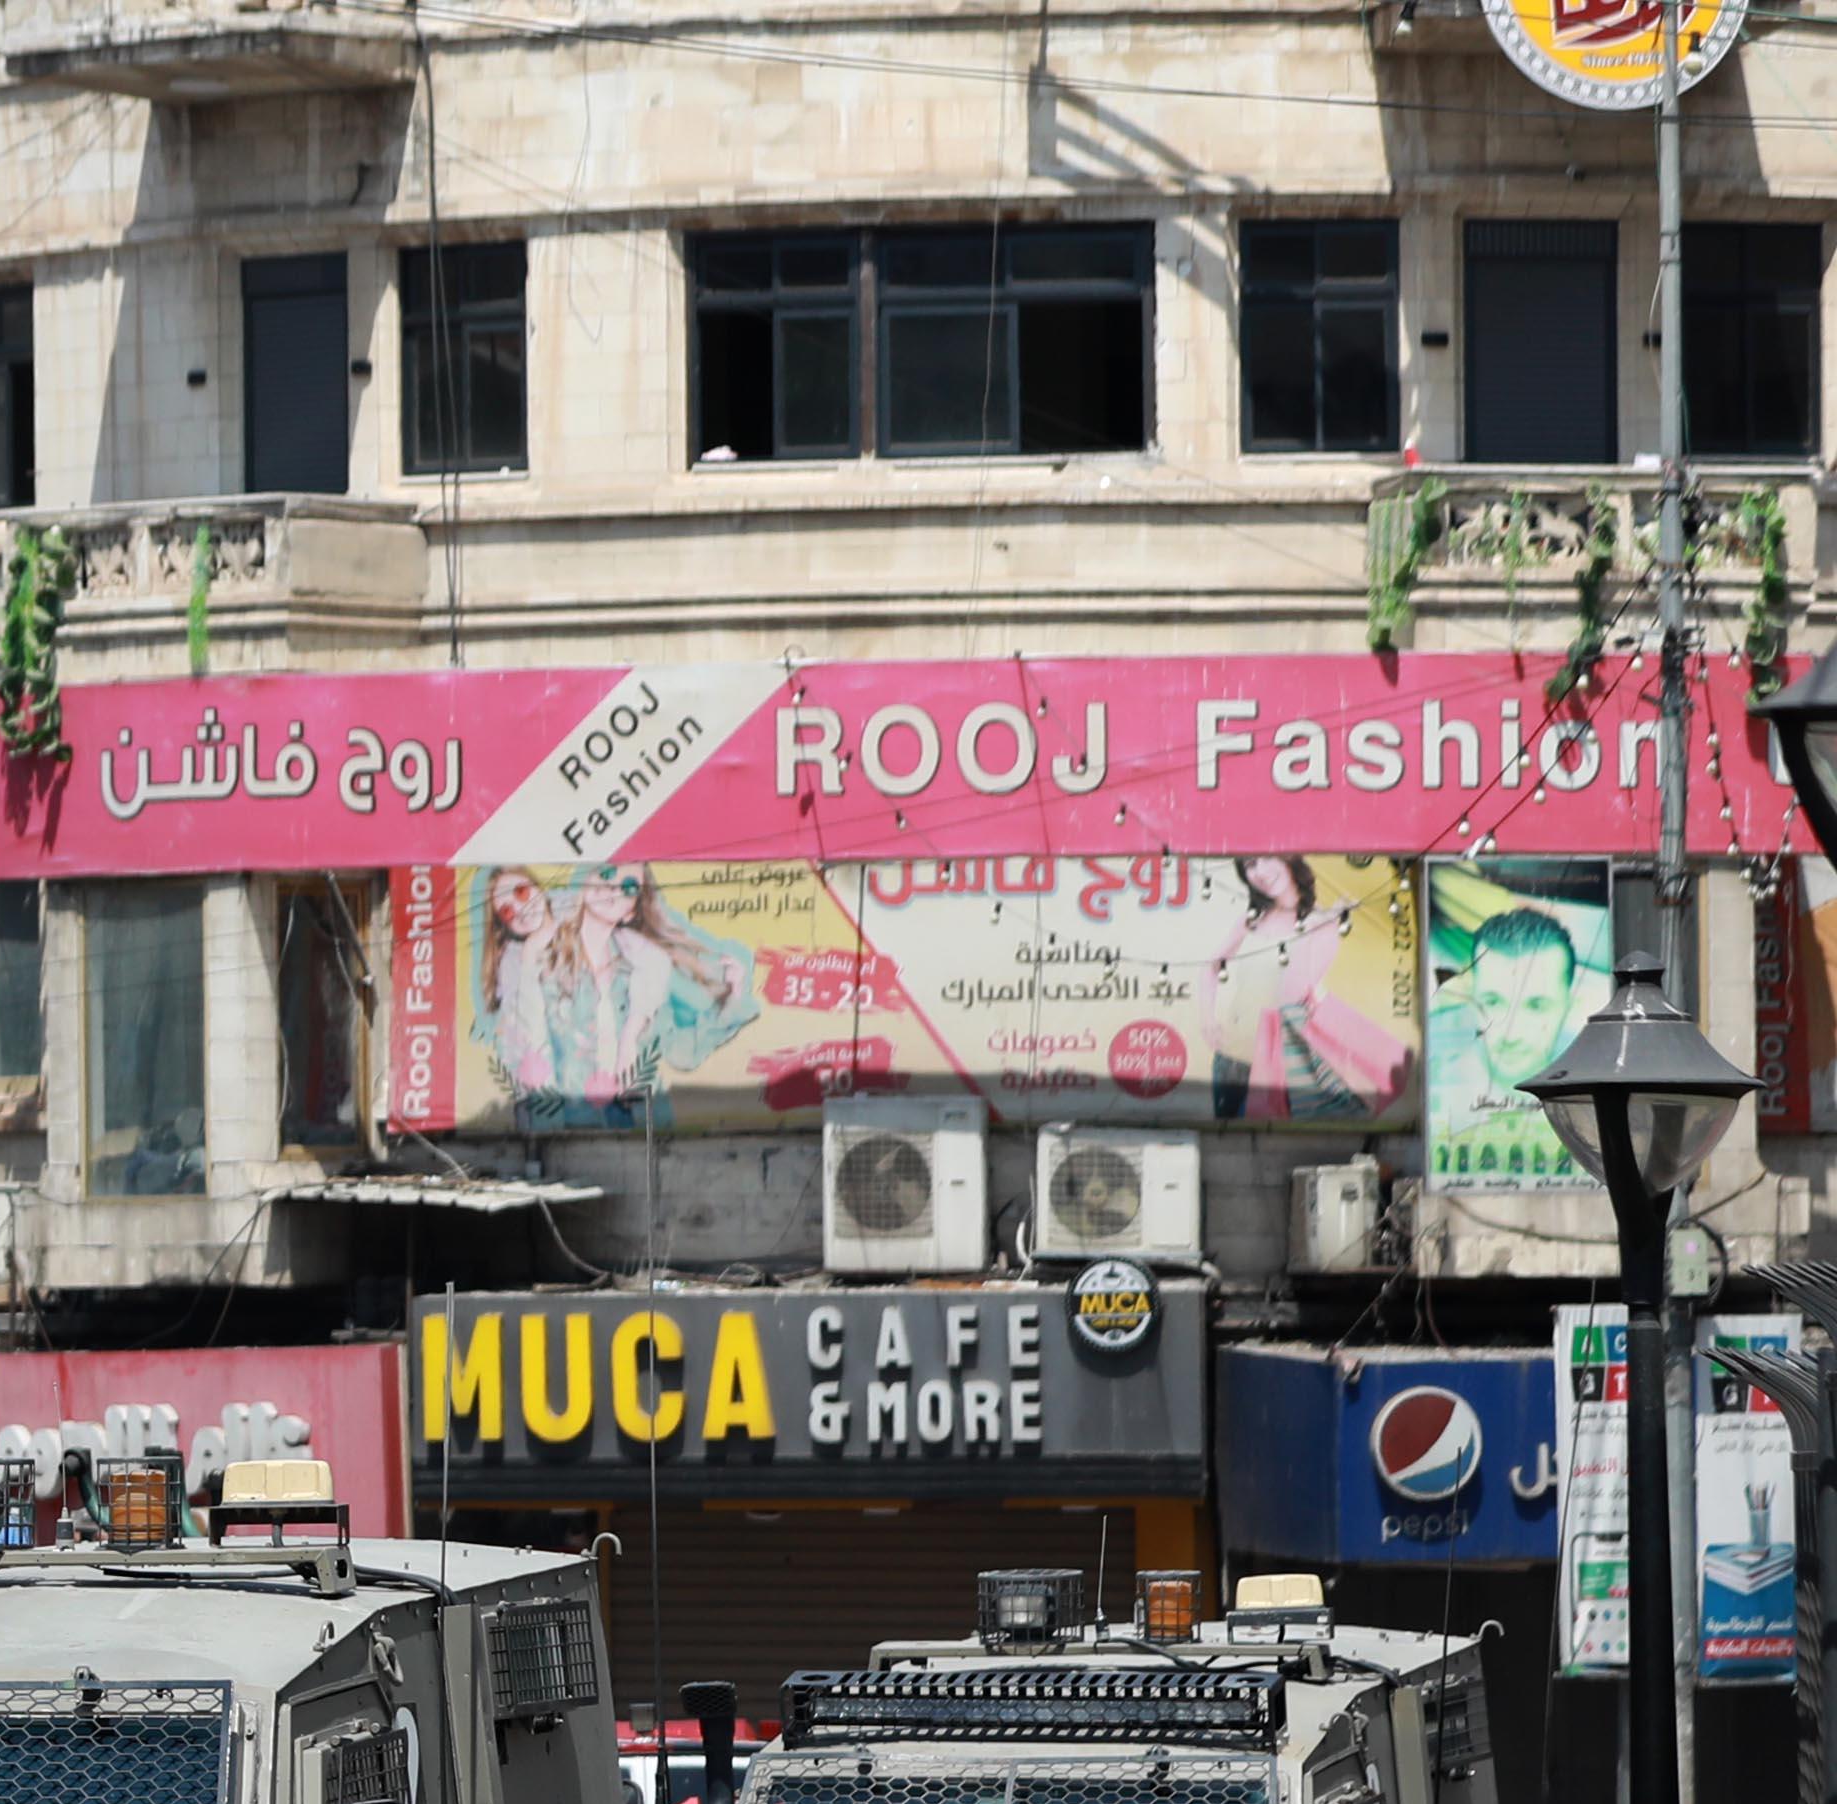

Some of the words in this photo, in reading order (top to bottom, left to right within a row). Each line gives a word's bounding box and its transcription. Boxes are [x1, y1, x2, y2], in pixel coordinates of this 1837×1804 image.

[557, 680, 661, 793] ROOJ
[775, 700, 1109, 796] ROOJ
[1194, 697, 1664, 792] Fashion
[100, 706, 318, 819] فاشن
[338, 726, 463, 813] روج
[560, 712, 705, 856] Fashion
[688, 895, 769, 921] الموسم
[1014, 941, 1122, 973] بمناسبة
[783, 975, 814, 1001] 35
[940, 977, 1035, 1011] المبارك
[1147, 978, 1192, 1003] عيد
[986, 1026, 1097, 1056] خصومات
[401, 1023, 440, 1119] Rooj
[1079, 1292, 1151, 1314] MUCA
[421, 1311, 777, 1443] MUCA
[807, 1304, 1041, 1369] CAFE
[1381, 1511, 1470, 1543] pepsi
